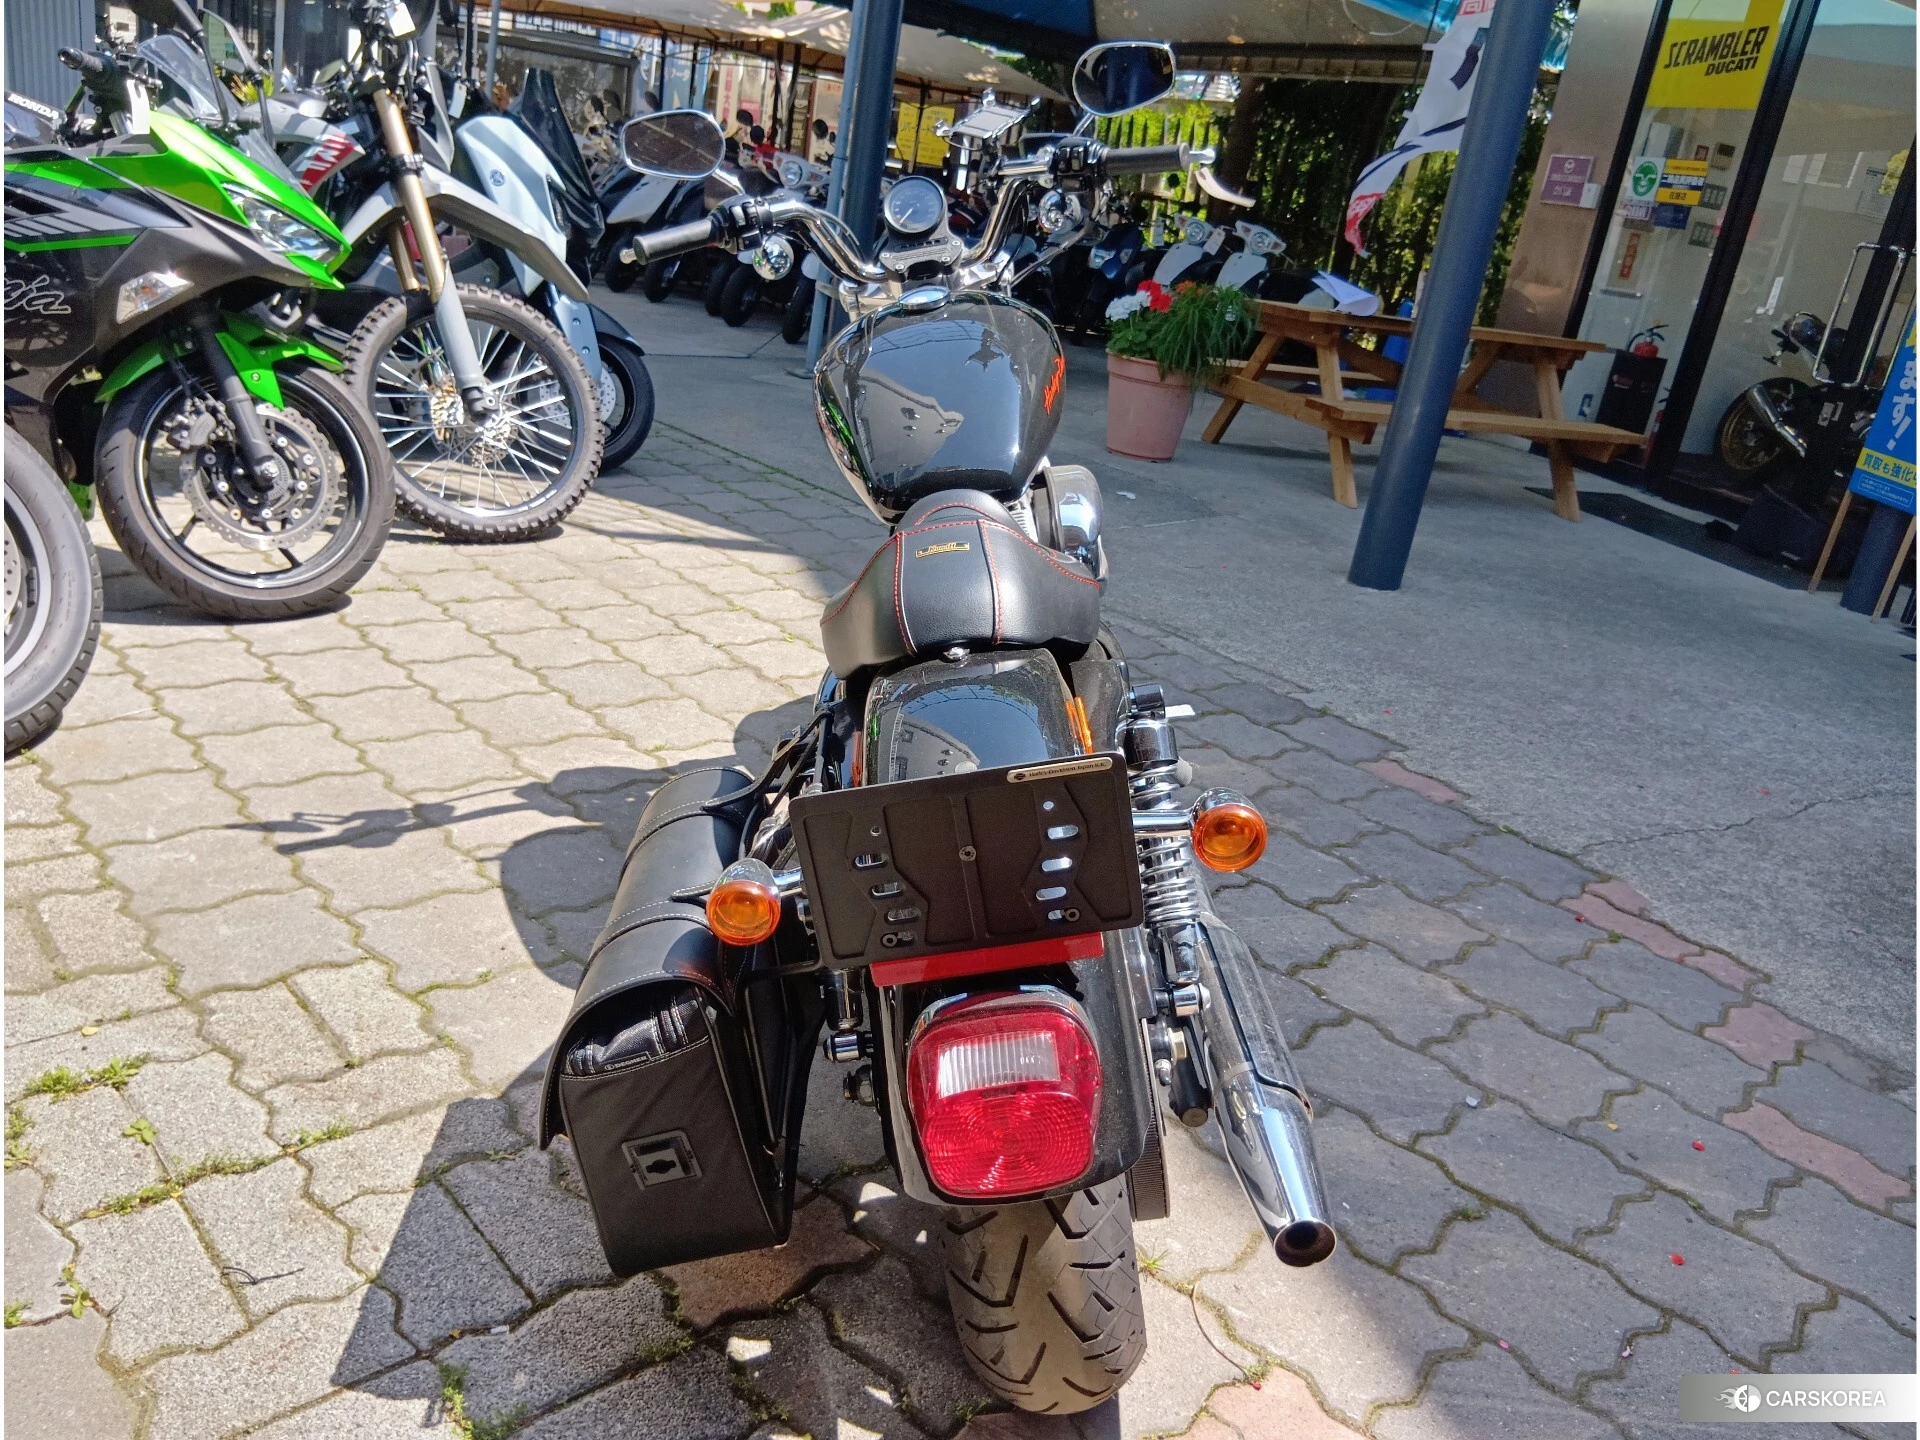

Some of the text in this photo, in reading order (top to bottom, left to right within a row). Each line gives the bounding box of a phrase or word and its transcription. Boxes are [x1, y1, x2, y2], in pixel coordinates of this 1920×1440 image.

[1663, 25, 1770, 69] SCRAMBLER
[1704, 56, 1759, 77] DUCATI
[8, 93, 59, 120] HONDA
[1029, 766, 1077, 778] Harley-Davidson
[1077, 763, 1094, 771] Japan
